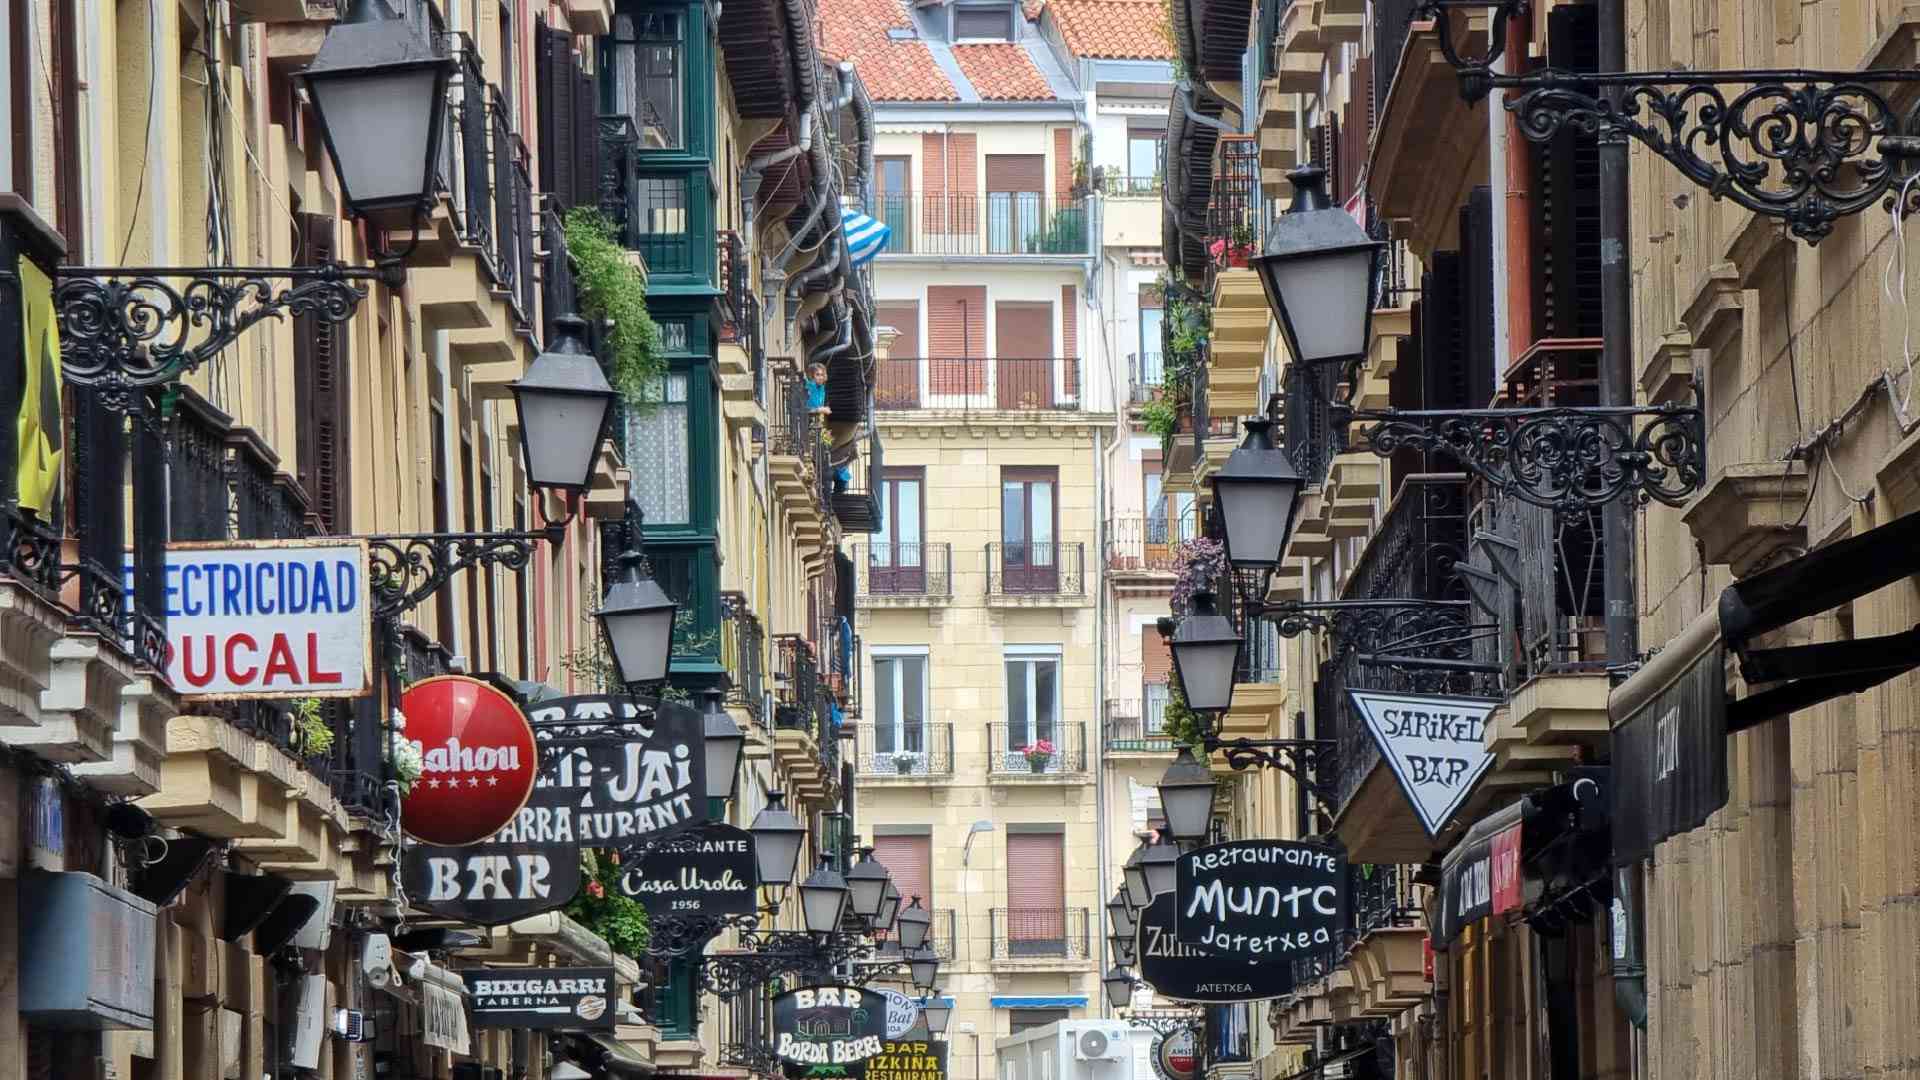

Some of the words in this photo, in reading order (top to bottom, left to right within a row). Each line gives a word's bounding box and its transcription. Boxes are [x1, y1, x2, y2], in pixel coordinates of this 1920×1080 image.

[121, 559, 357, 617] EECTRICIDAD
[1405, 754, 1469, 789] BAR
[1191, 846, 1337, 877] Restaurante
[427, 854, 551, 901] BAR
[622, 867, 679, 896] Casa
[680, 866, 748, 891] Urola
[671, 900, 701, 910] 1956
[1200, 924, 1330, 953] Jatetxea
[474, 978, 606, 995] BIXIGARRI
[795, 987, 862, 1009] BAR
[1194, 983, 1253, 993] JATETXEA
[476, 997, 560, 1007] TABERNA
[778, 1033, 830, 1064] BORDA
